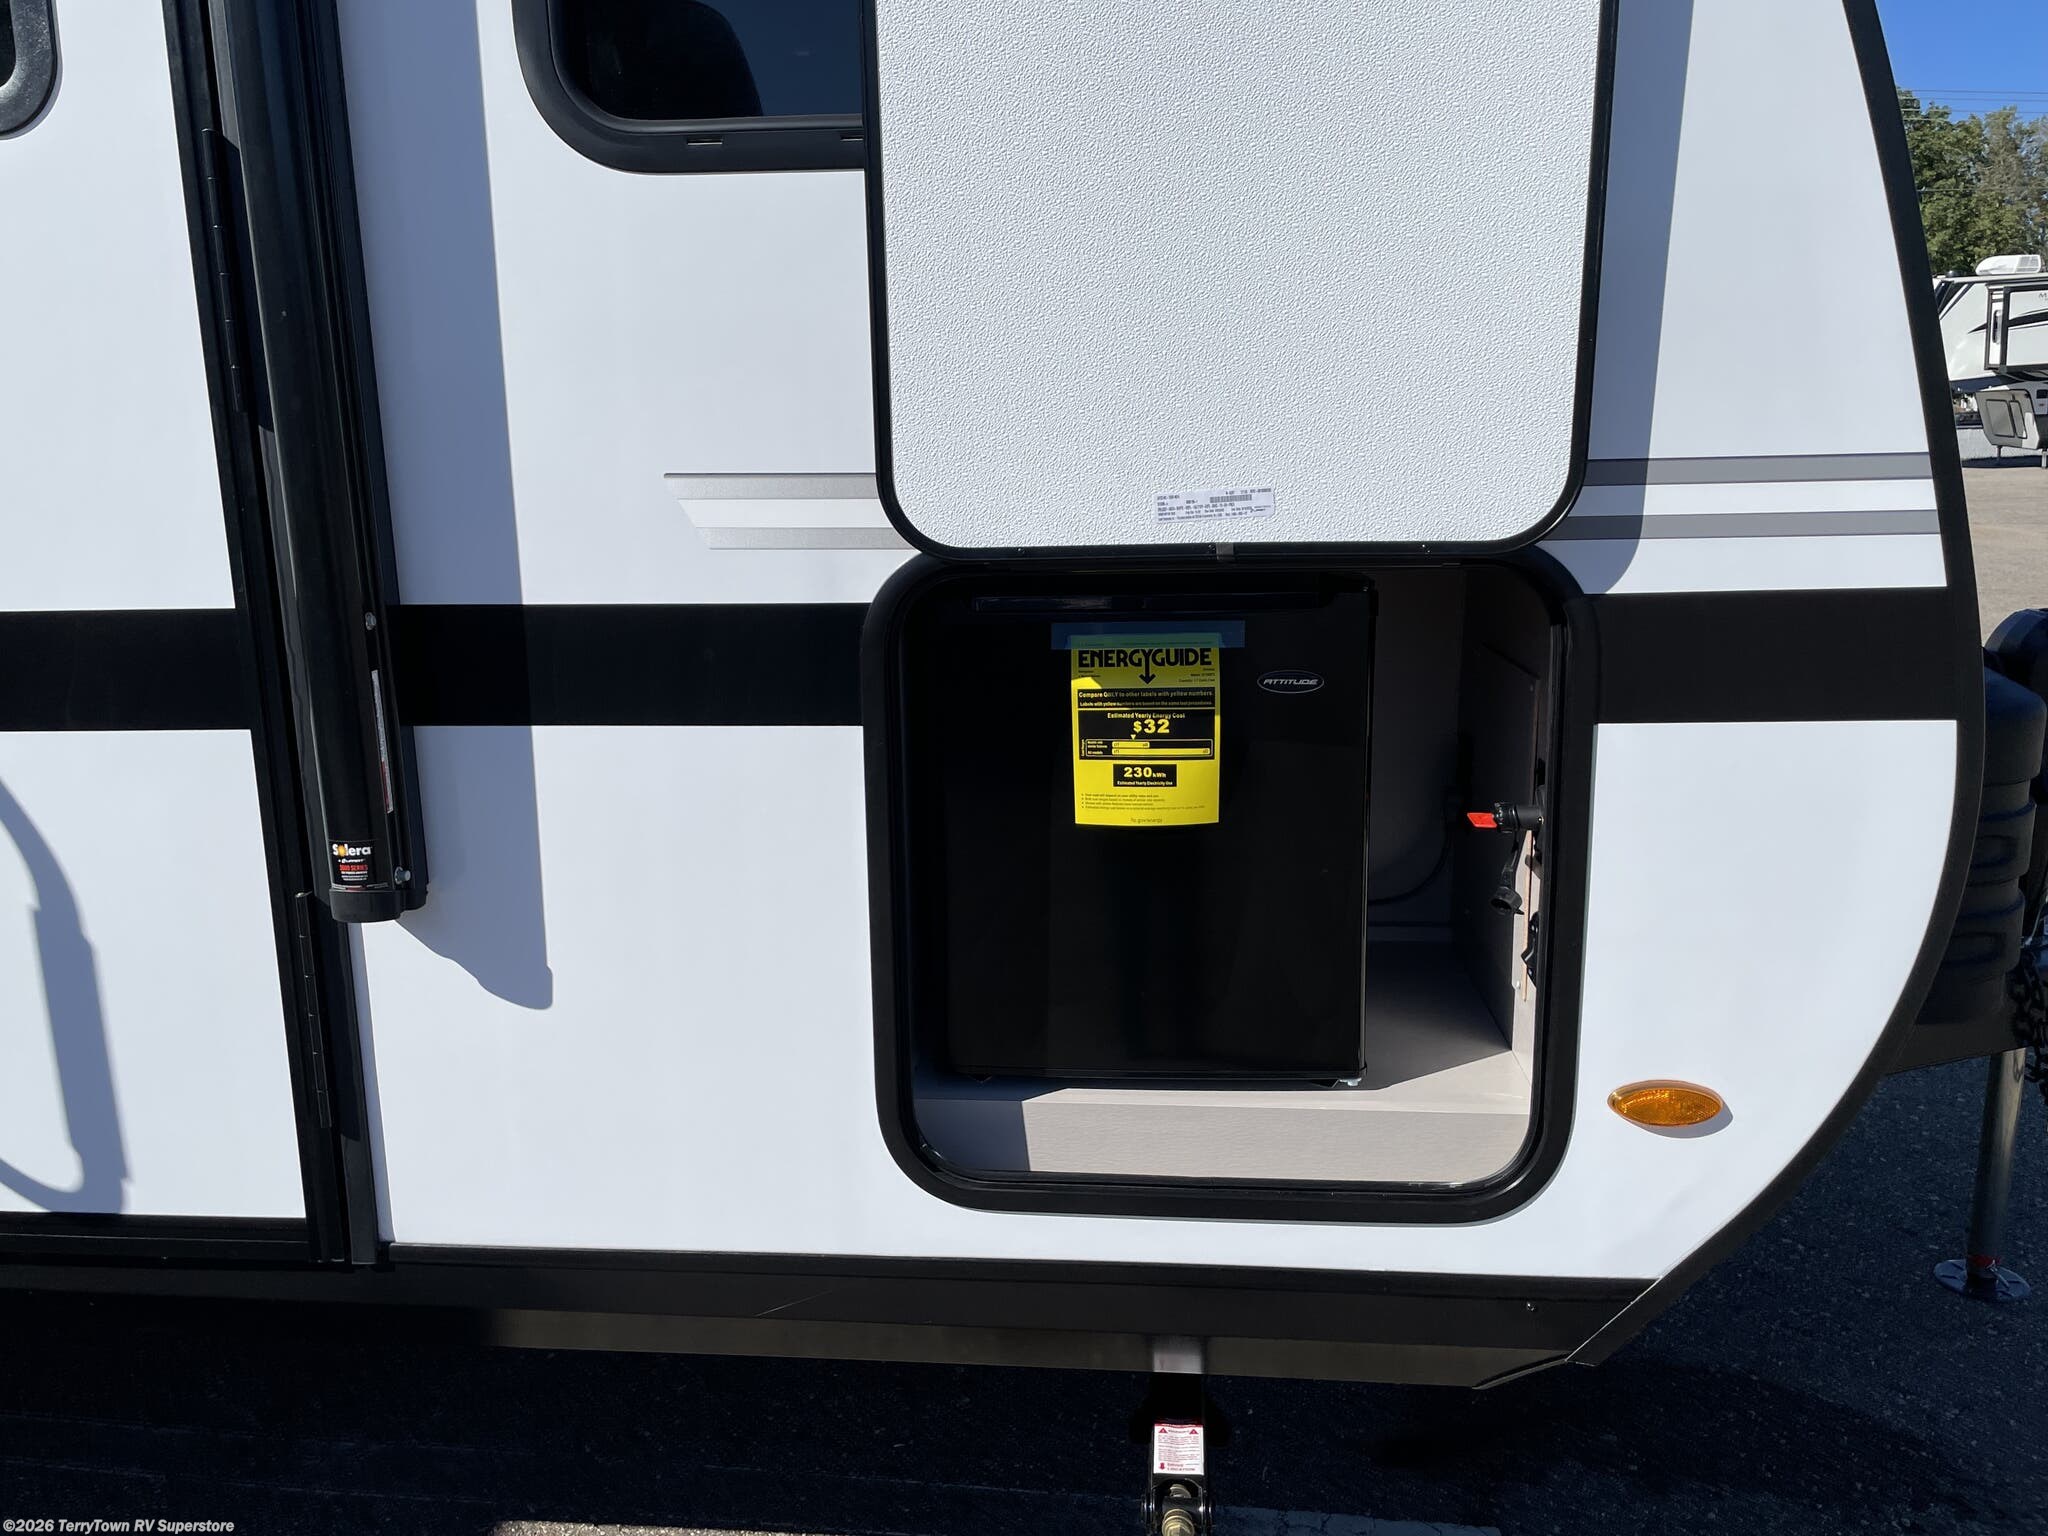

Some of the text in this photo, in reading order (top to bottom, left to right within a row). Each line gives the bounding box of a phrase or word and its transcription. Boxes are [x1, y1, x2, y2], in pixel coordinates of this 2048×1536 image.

[1078, 648, 1212, 668] ENERGYGUIDE
[1079, 691, 1103, 699] Compare
[1152, 712, 1171, 720] Energy
[1133, 718, 1170, 734] $32
[1123, 766, 1152, 778] 230
[332, 843, 372, 858] Solera
